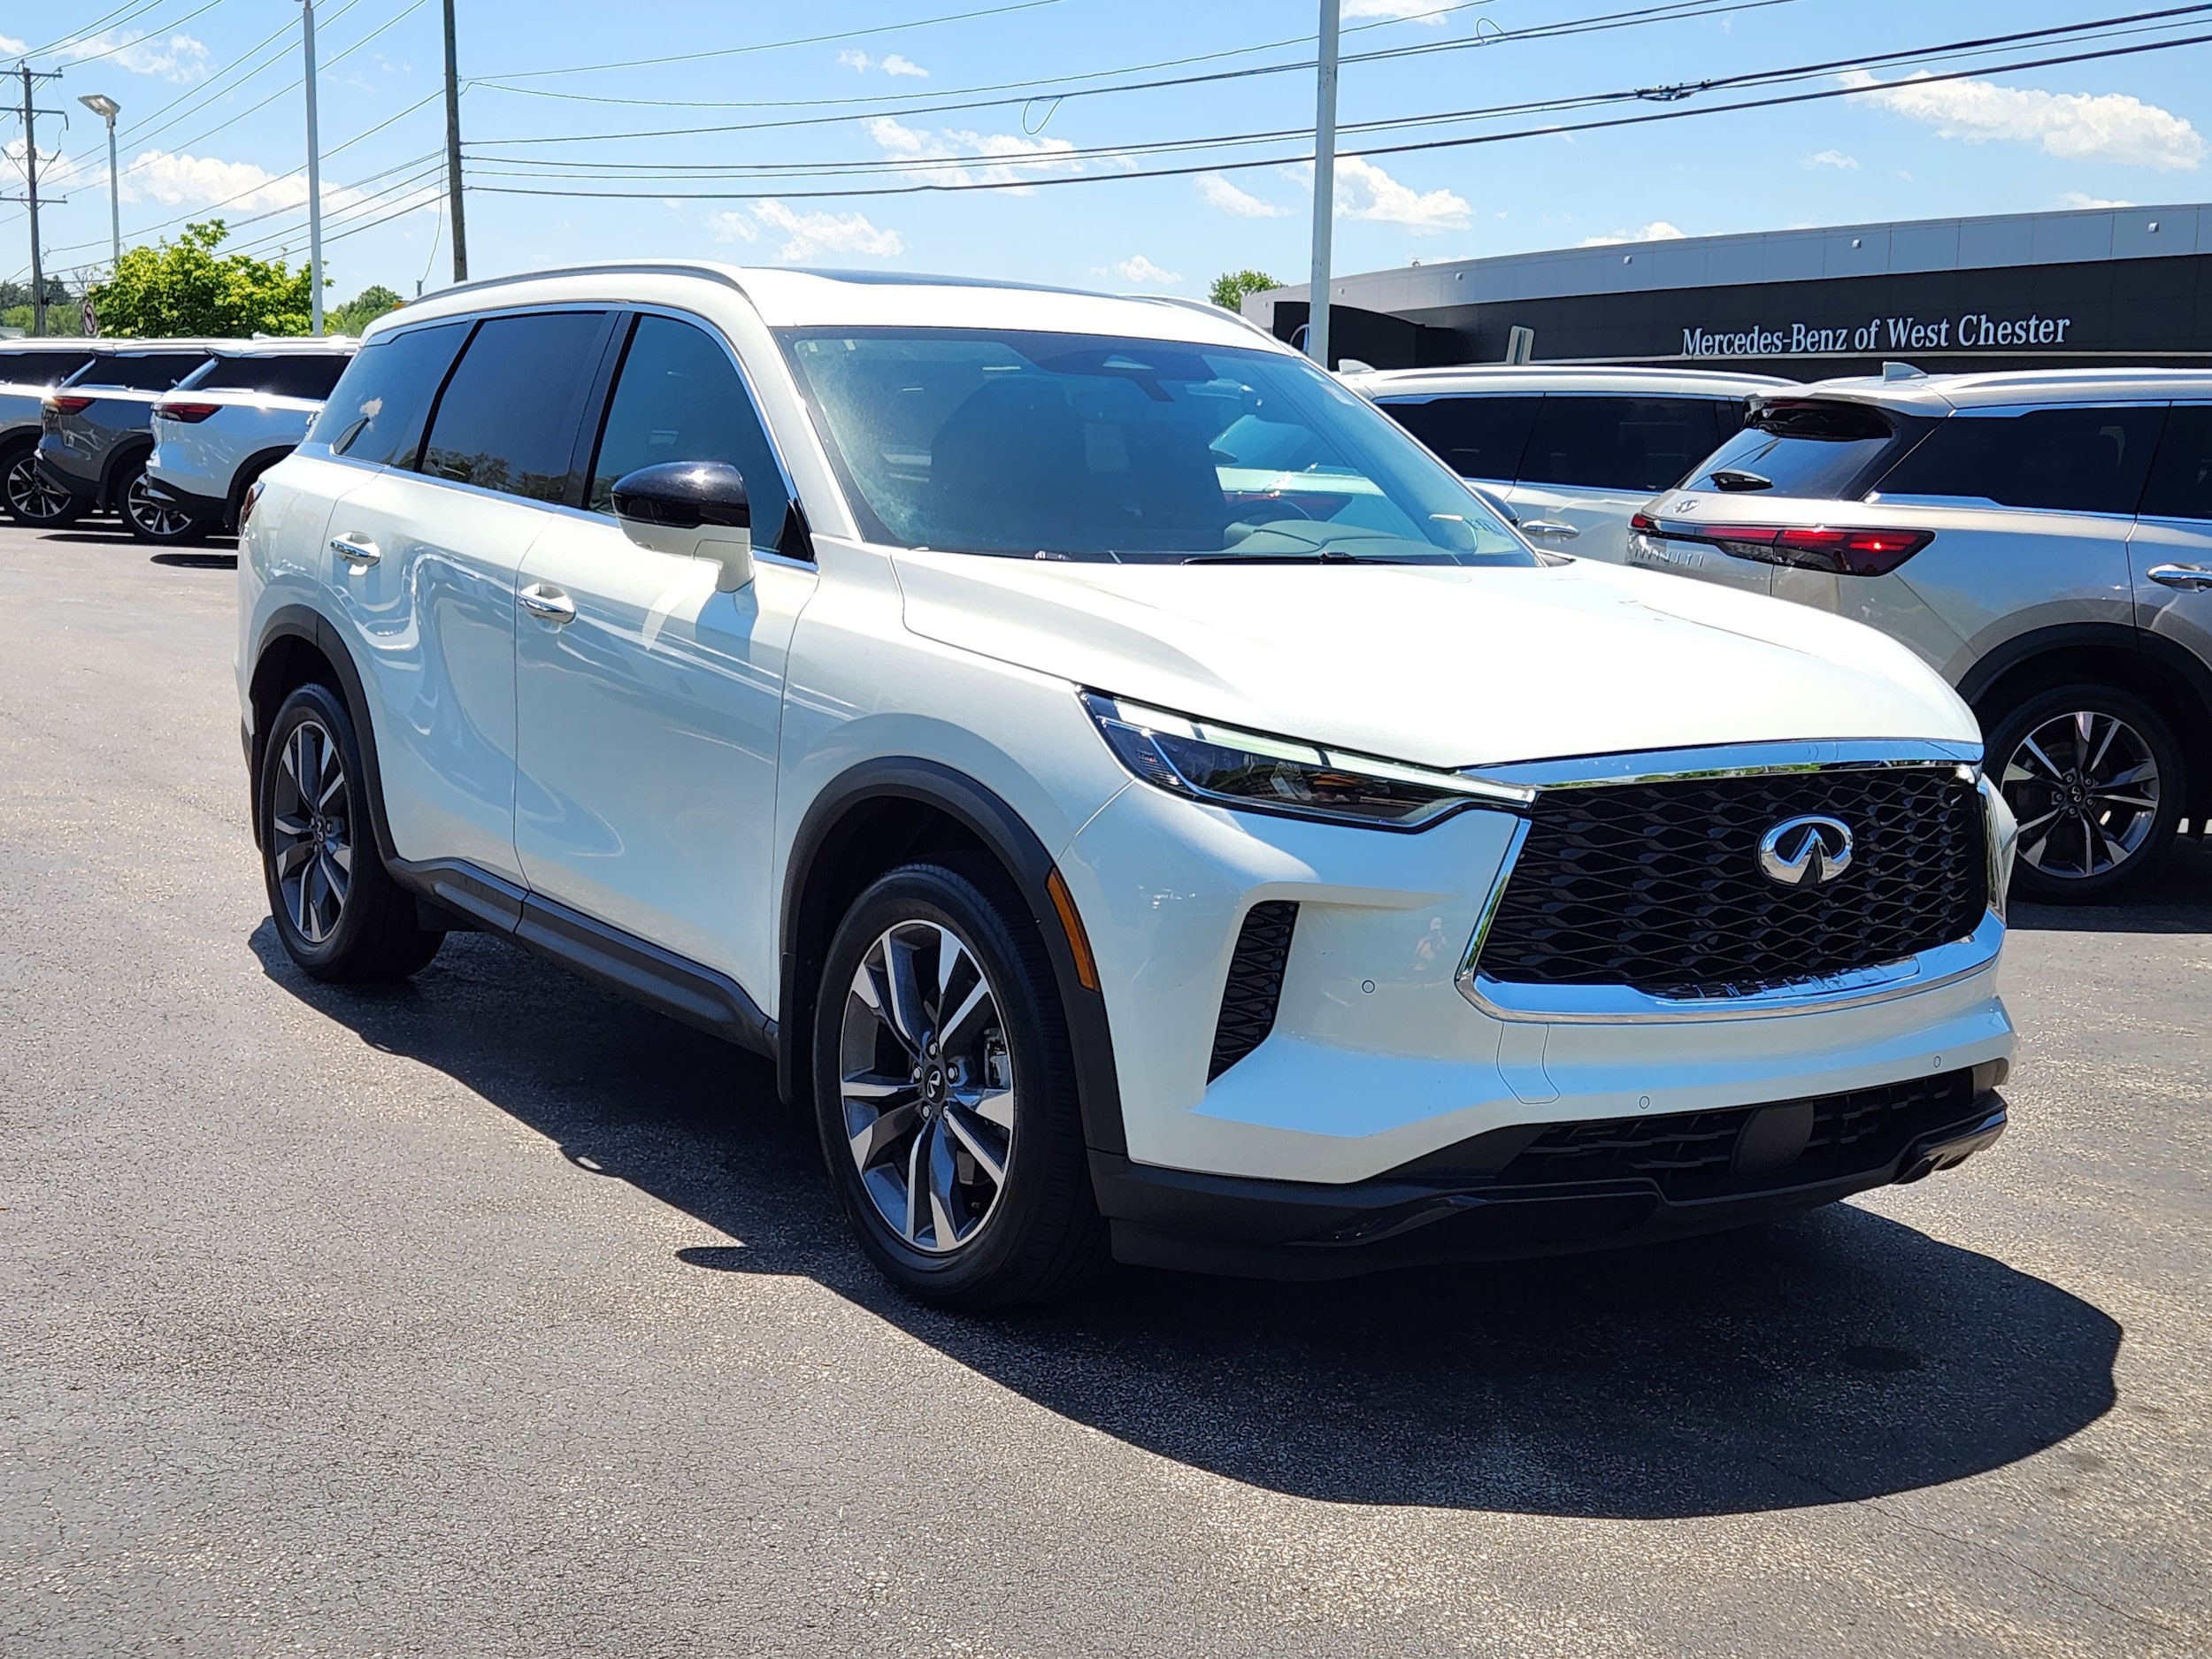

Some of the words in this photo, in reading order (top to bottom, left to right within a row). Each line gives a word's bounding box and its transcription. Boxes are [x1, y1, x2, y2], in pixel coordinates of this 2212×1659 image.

[1682, 323, 1848, 356] Mercedes-Benz
[1855, 319, 1880, 349] of
[1886, 317, 1950, 348] West
[1958, 314, 2070, 346] Chester
